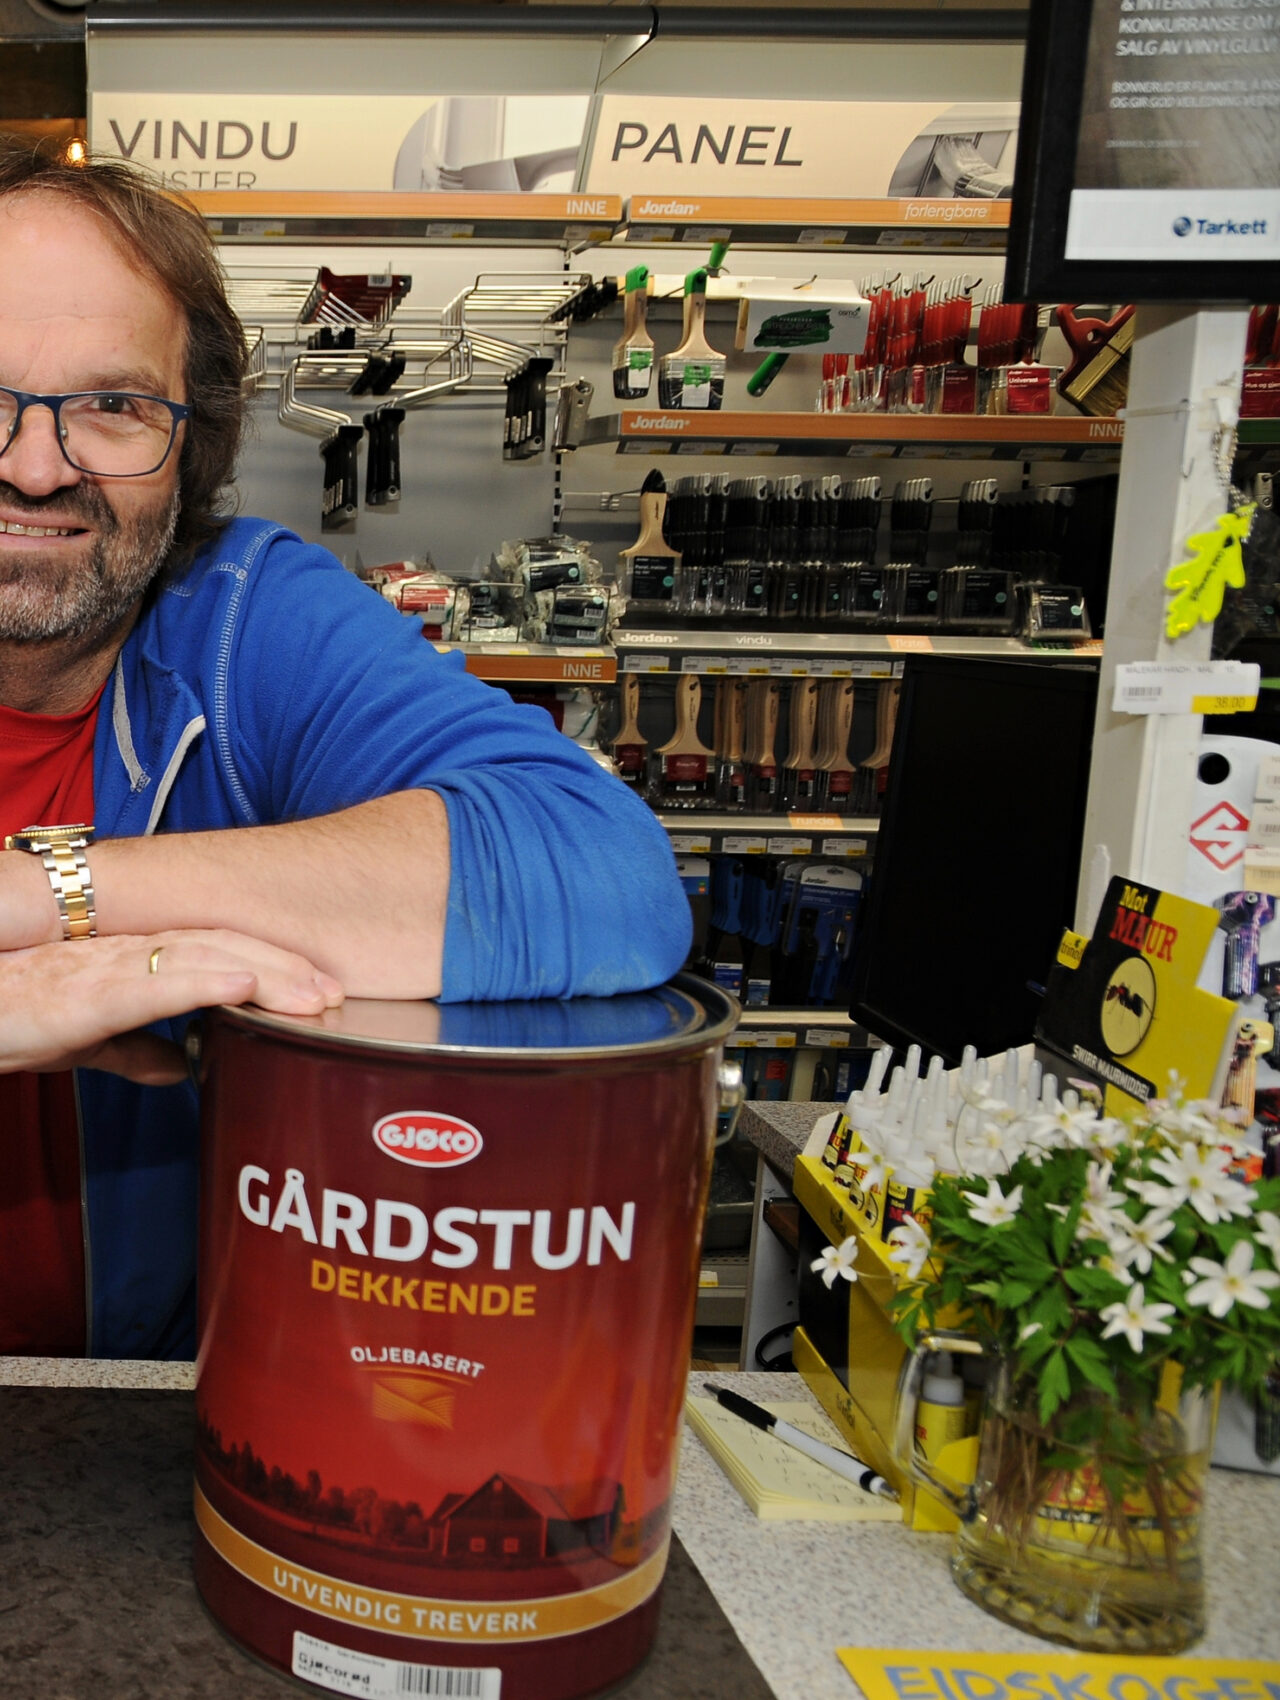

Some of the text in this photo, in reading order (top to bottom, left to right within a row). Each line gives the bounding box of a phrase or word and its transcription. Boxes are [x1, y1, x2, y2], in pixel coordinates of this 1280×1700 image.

[1115, 40, 1158, 56] SALG
[109, 119, 297, 160] VINDU
[611, 122, 804, 167] PANEL
[567, 200, 607, 215] INNE
[639, 200, 696, 215] Jordan
[905, 203, 988, 221] forlengbare
[1197, 219, 1267, 234] Tarkett
[630, 416, 685, 429] Jordan
[621, 634, 673, 644] Jordan
[736, 636, 772, 645] vindu
[563, 664, 602, 678] INNE
[1120, 885, 1150, 913] Mot
[1109, 906, 1178, 963] MAUR
[379, 1124, 476, 1157] GJØCO
[238, 1164, 635, 1270] GÅRDSTUN
[310, 1260, 536, 1317] DEKKENDE
[350, 1345, 485, 1380] OLJEBASERT
[273, 1565, 538, 1634] UTVENDIG TREVERK
